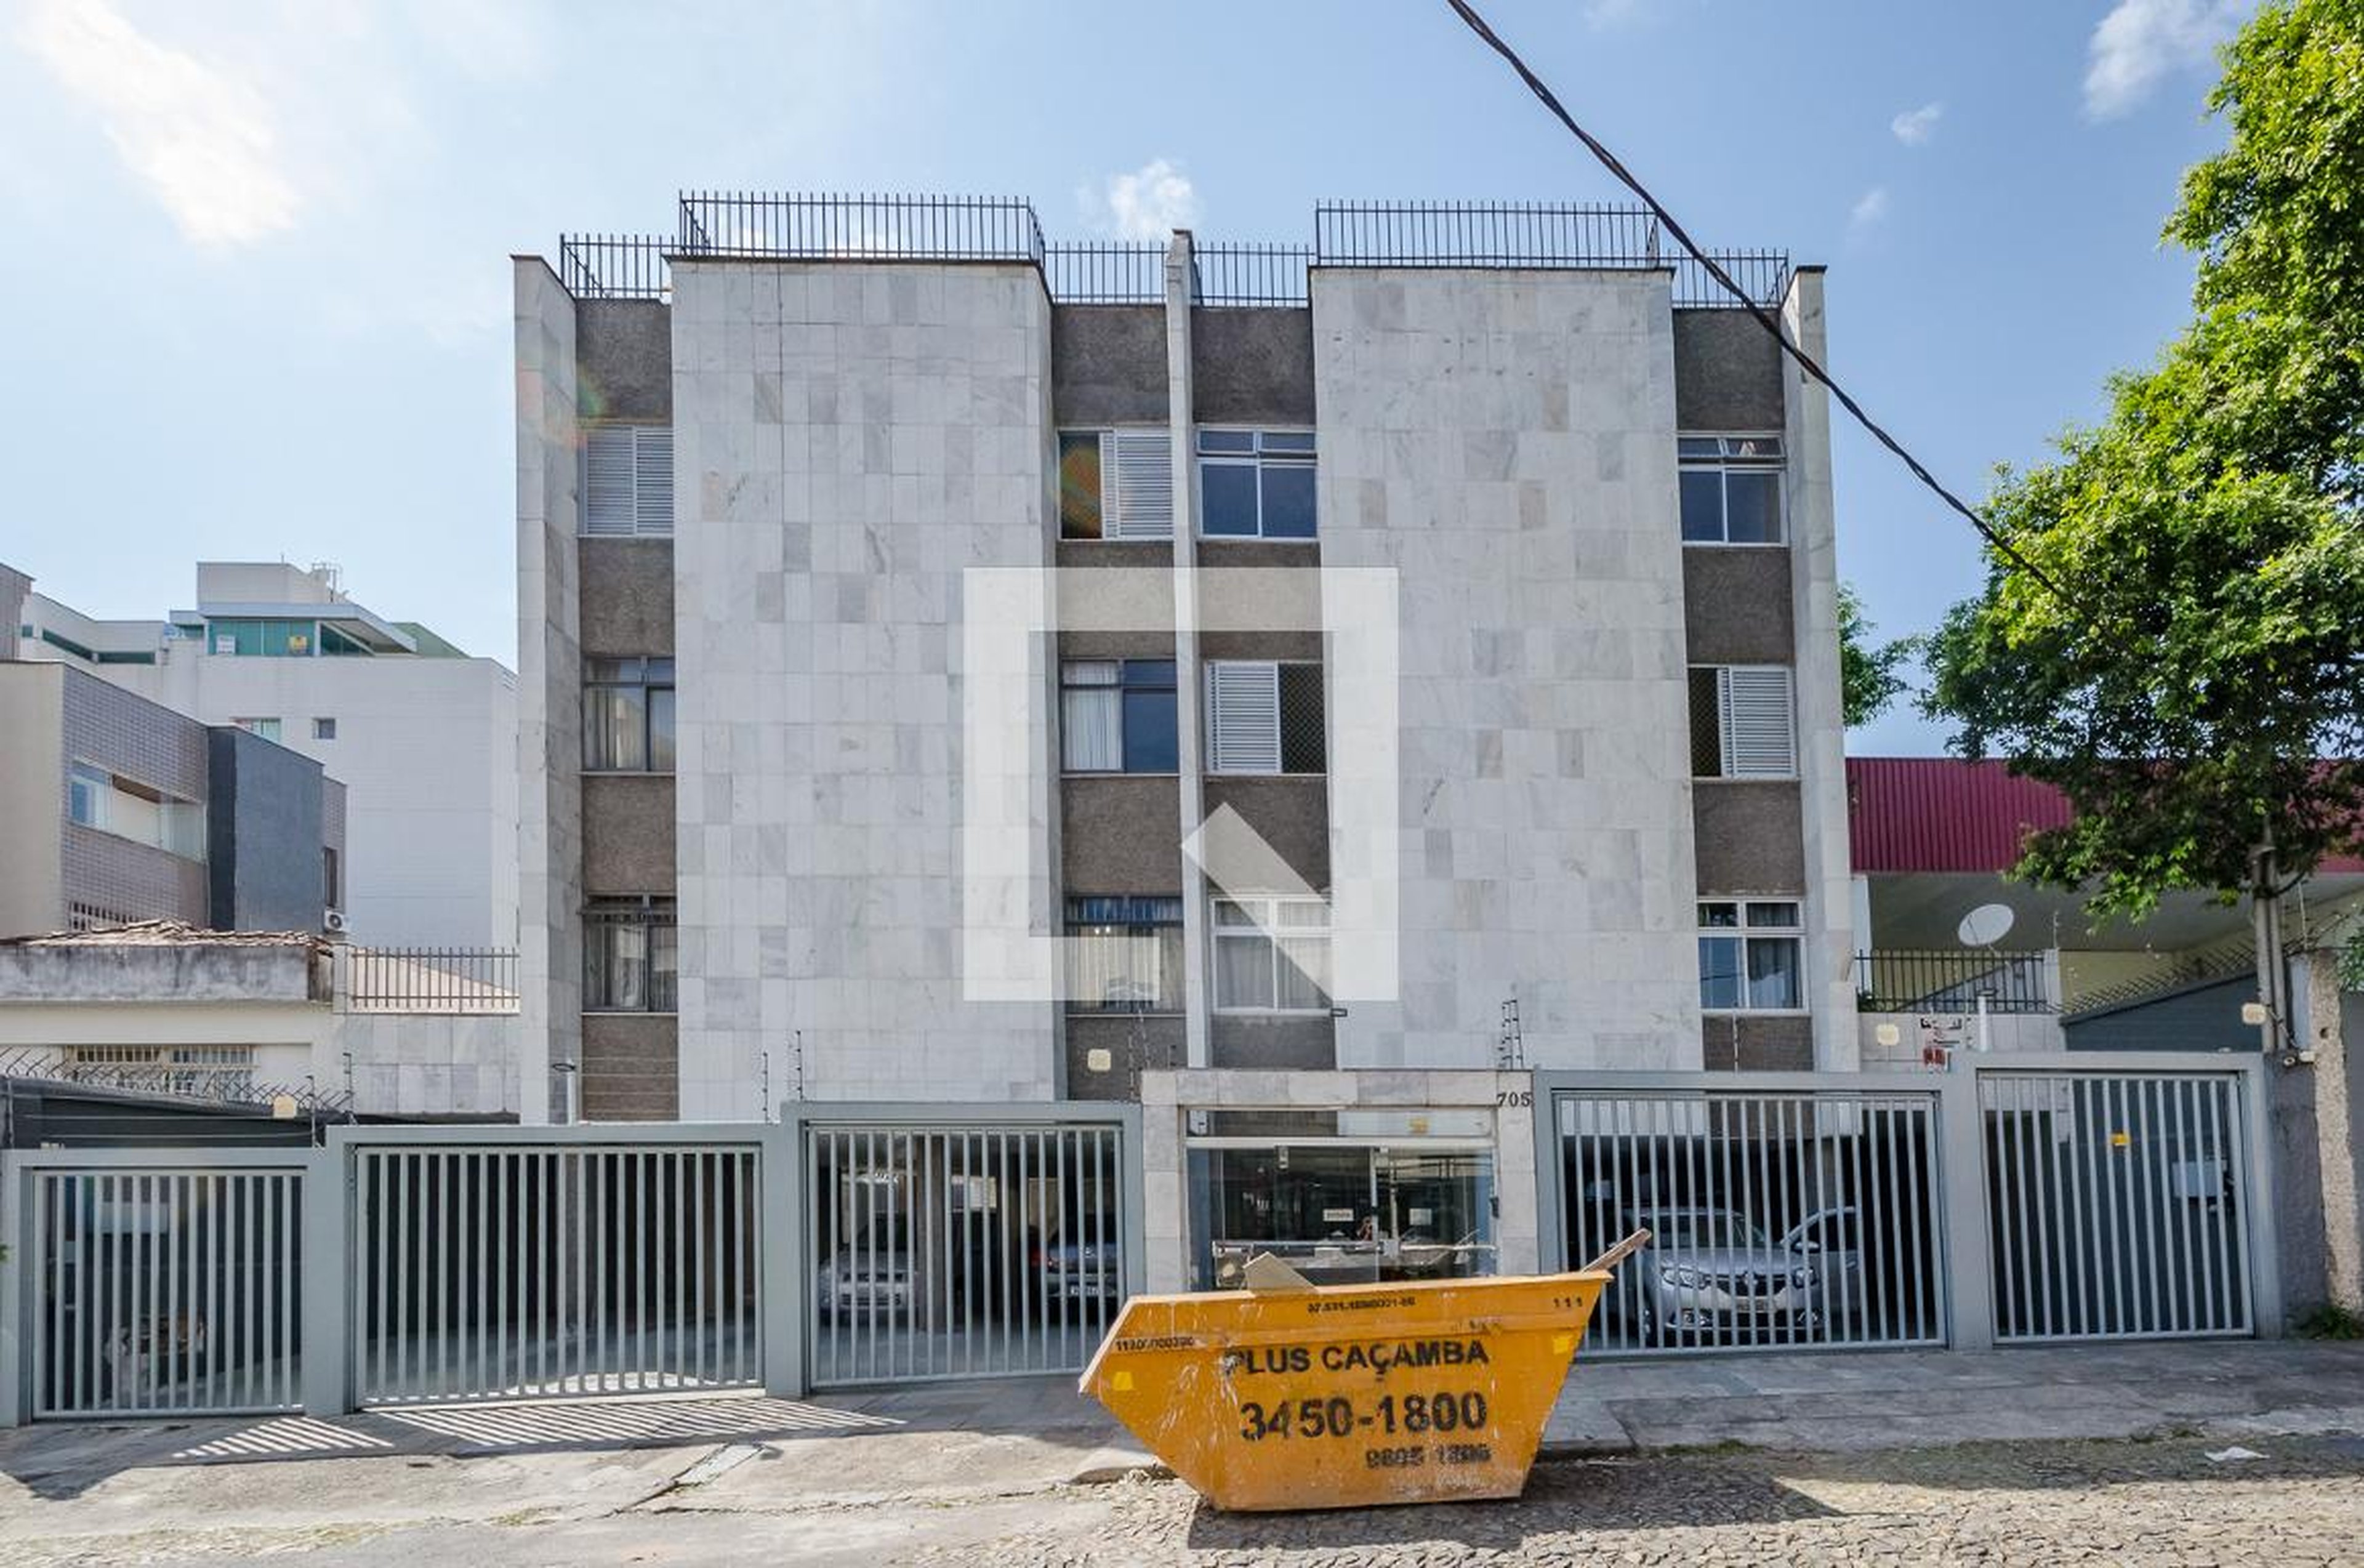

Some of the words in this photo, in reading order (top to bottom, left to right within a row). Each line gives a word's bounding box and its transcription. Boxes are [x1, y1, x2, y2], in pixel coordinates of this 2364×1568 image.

[1497, 1092, 1532, 1108] 705
[1321, 1340, 1490, 1381] CAÇAMBA
[1240, 1392, 1487, 1441] 3450-1800
